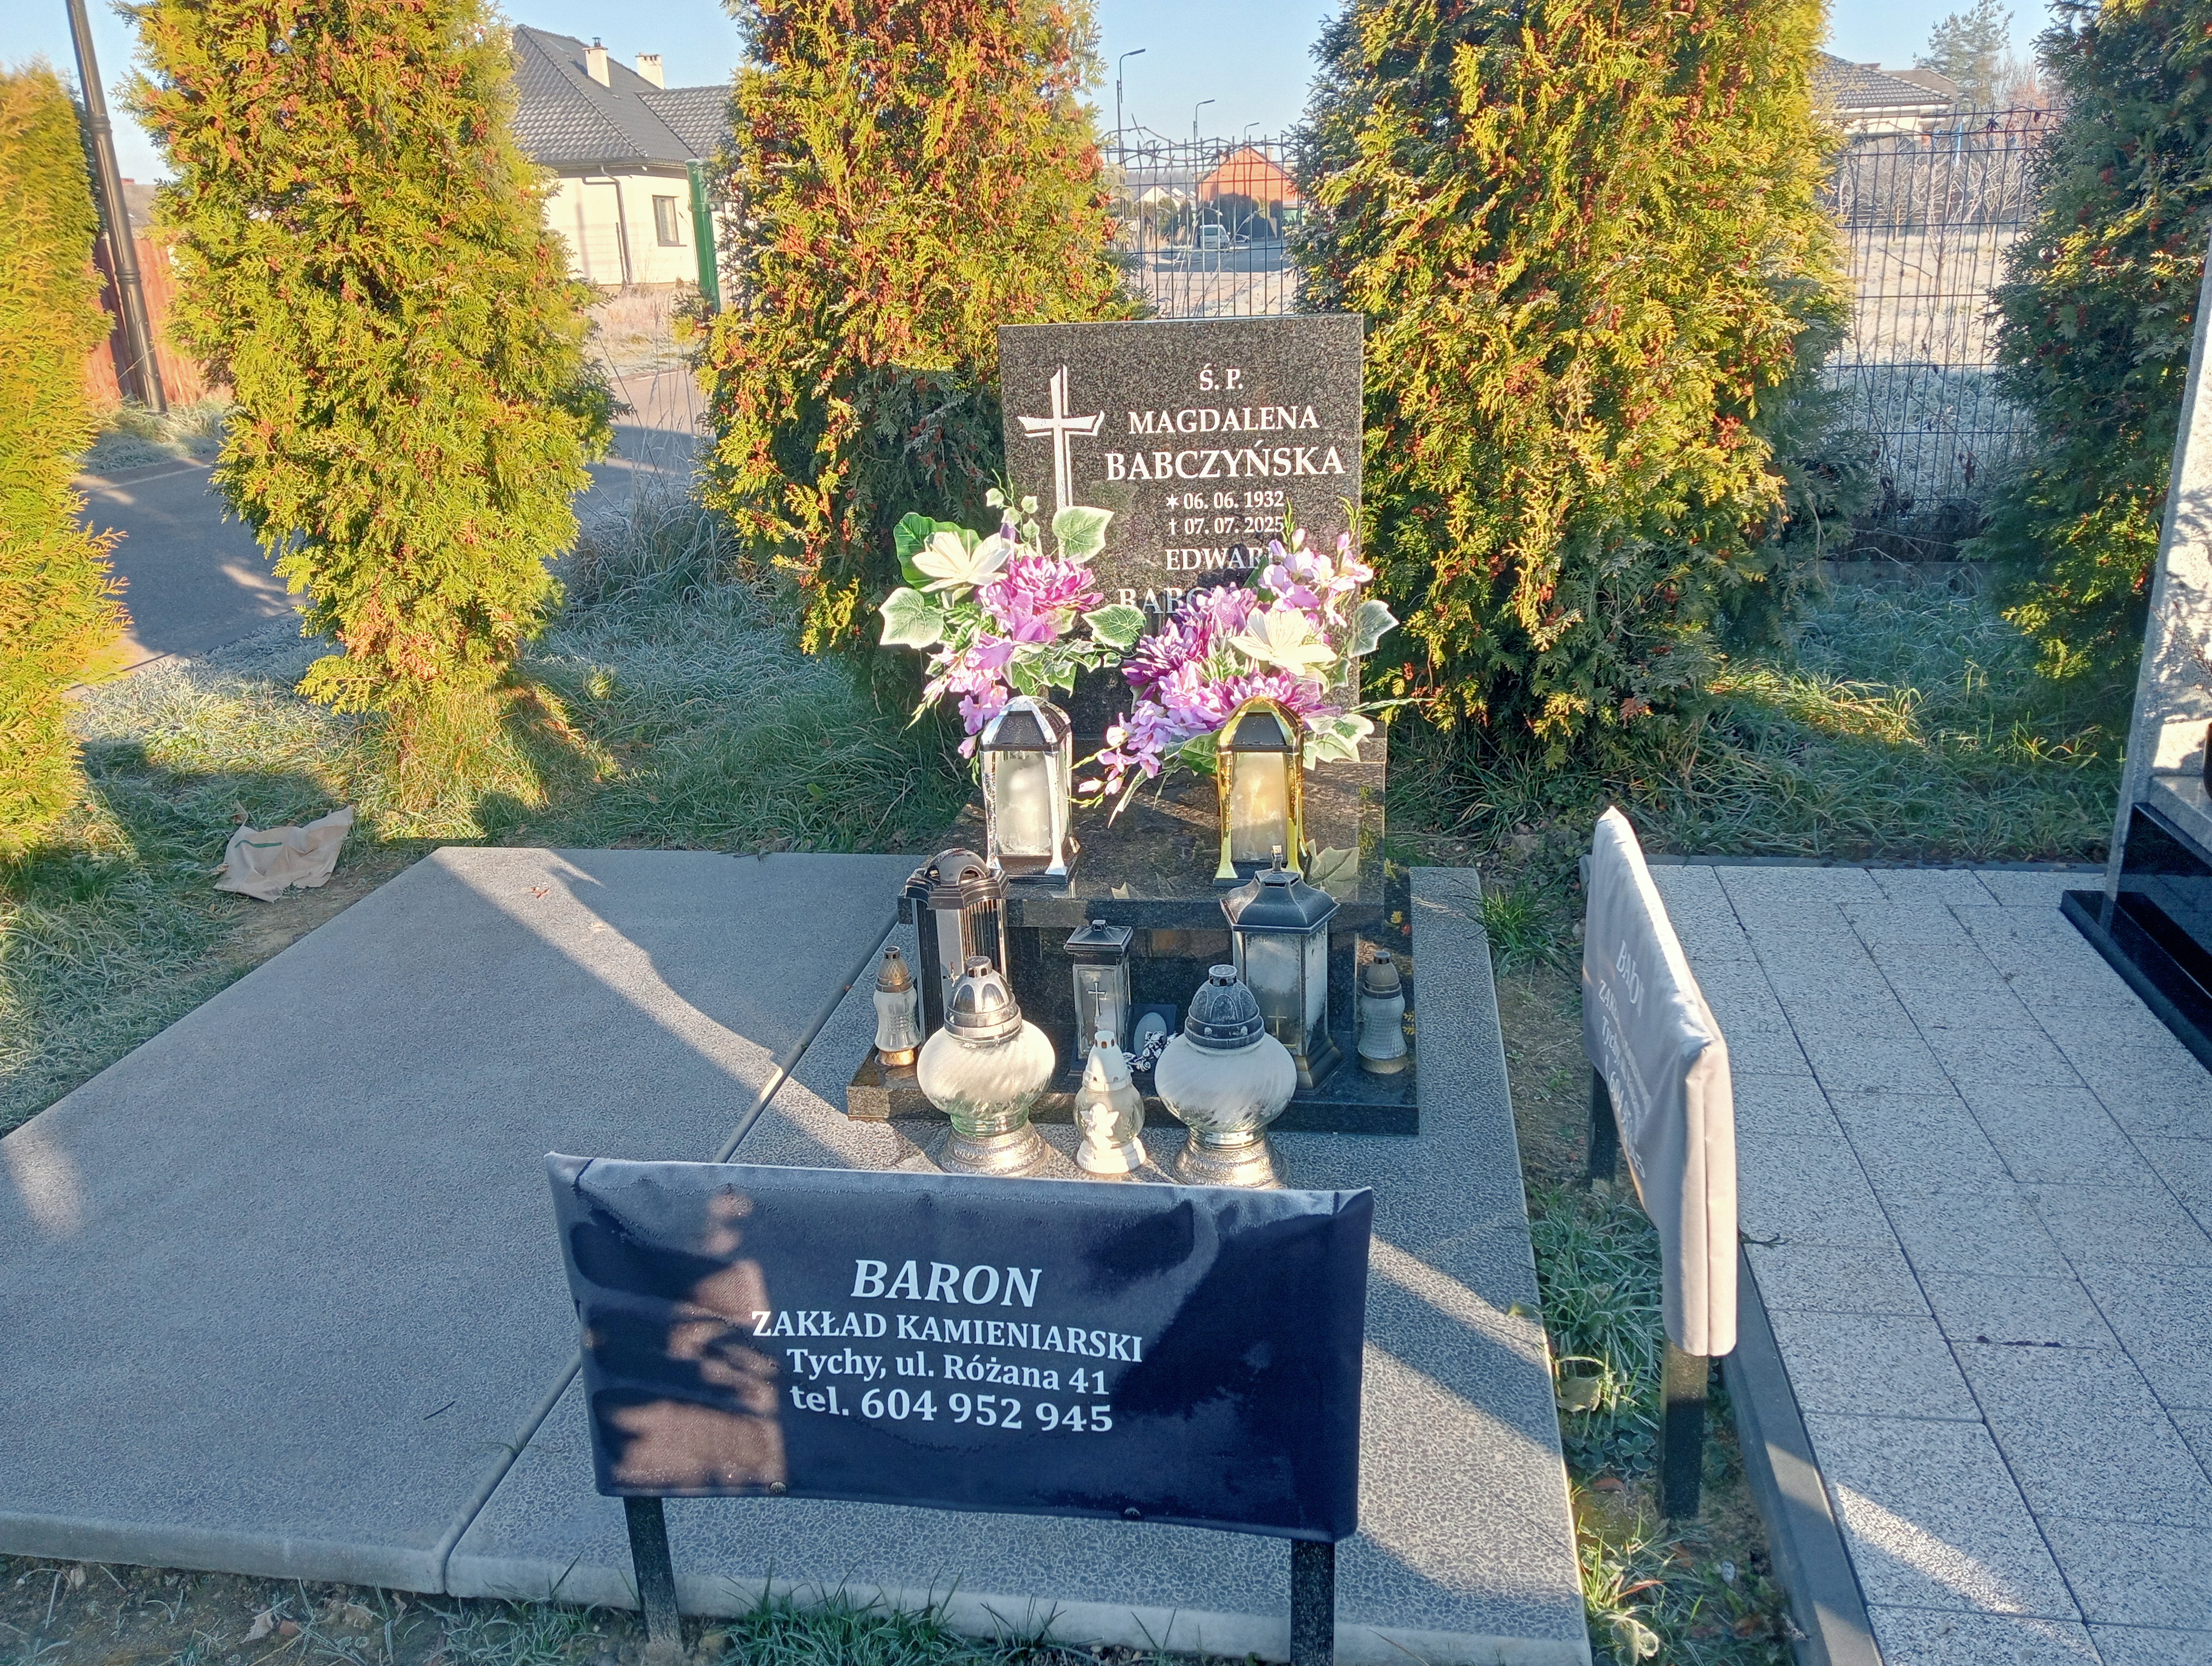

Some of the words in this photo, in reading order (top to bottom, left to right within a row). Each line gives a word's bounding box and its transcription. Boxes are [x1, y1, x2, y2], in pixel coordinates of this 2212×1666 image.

[1199, 363, 1219, 391] Ś.
[1225, 368, 1243, 390] P.
[1128, 405, 1320, 434] MAGDALENA
[1104, 439, 1346, 481] BABCZYŃSKA
[1183, 492, 1208, 510] 06.
[1213, 491, 1239, 509] 06.
[1244, 490, 1284, 508] 1932
[1184, 517, 1210, 535] 07.
[1214, 517, 1239, 534] 07.
[1244, 516, 1284, 533] 2025
[850, 1259, 1043, 1308] BARON
[751, 1310, 887, 1338] ZAKŁAD
[896, 1314, 1142, 1363] KAMIENIARSKI
[786, 1348, 886, 1382] Tychy,
[895, 1350, 935, 1377] ul.
[943, 1354, 1060, 1391] Różana
[1068, 1367, 1110, 1395] 41
[789, 1385, 850, 1417] tel.
[861, 1388, 938, 1421] 604
[948, 1392, 1022, 1430] 952
[1035, 1402, 1113, 1432] 945
